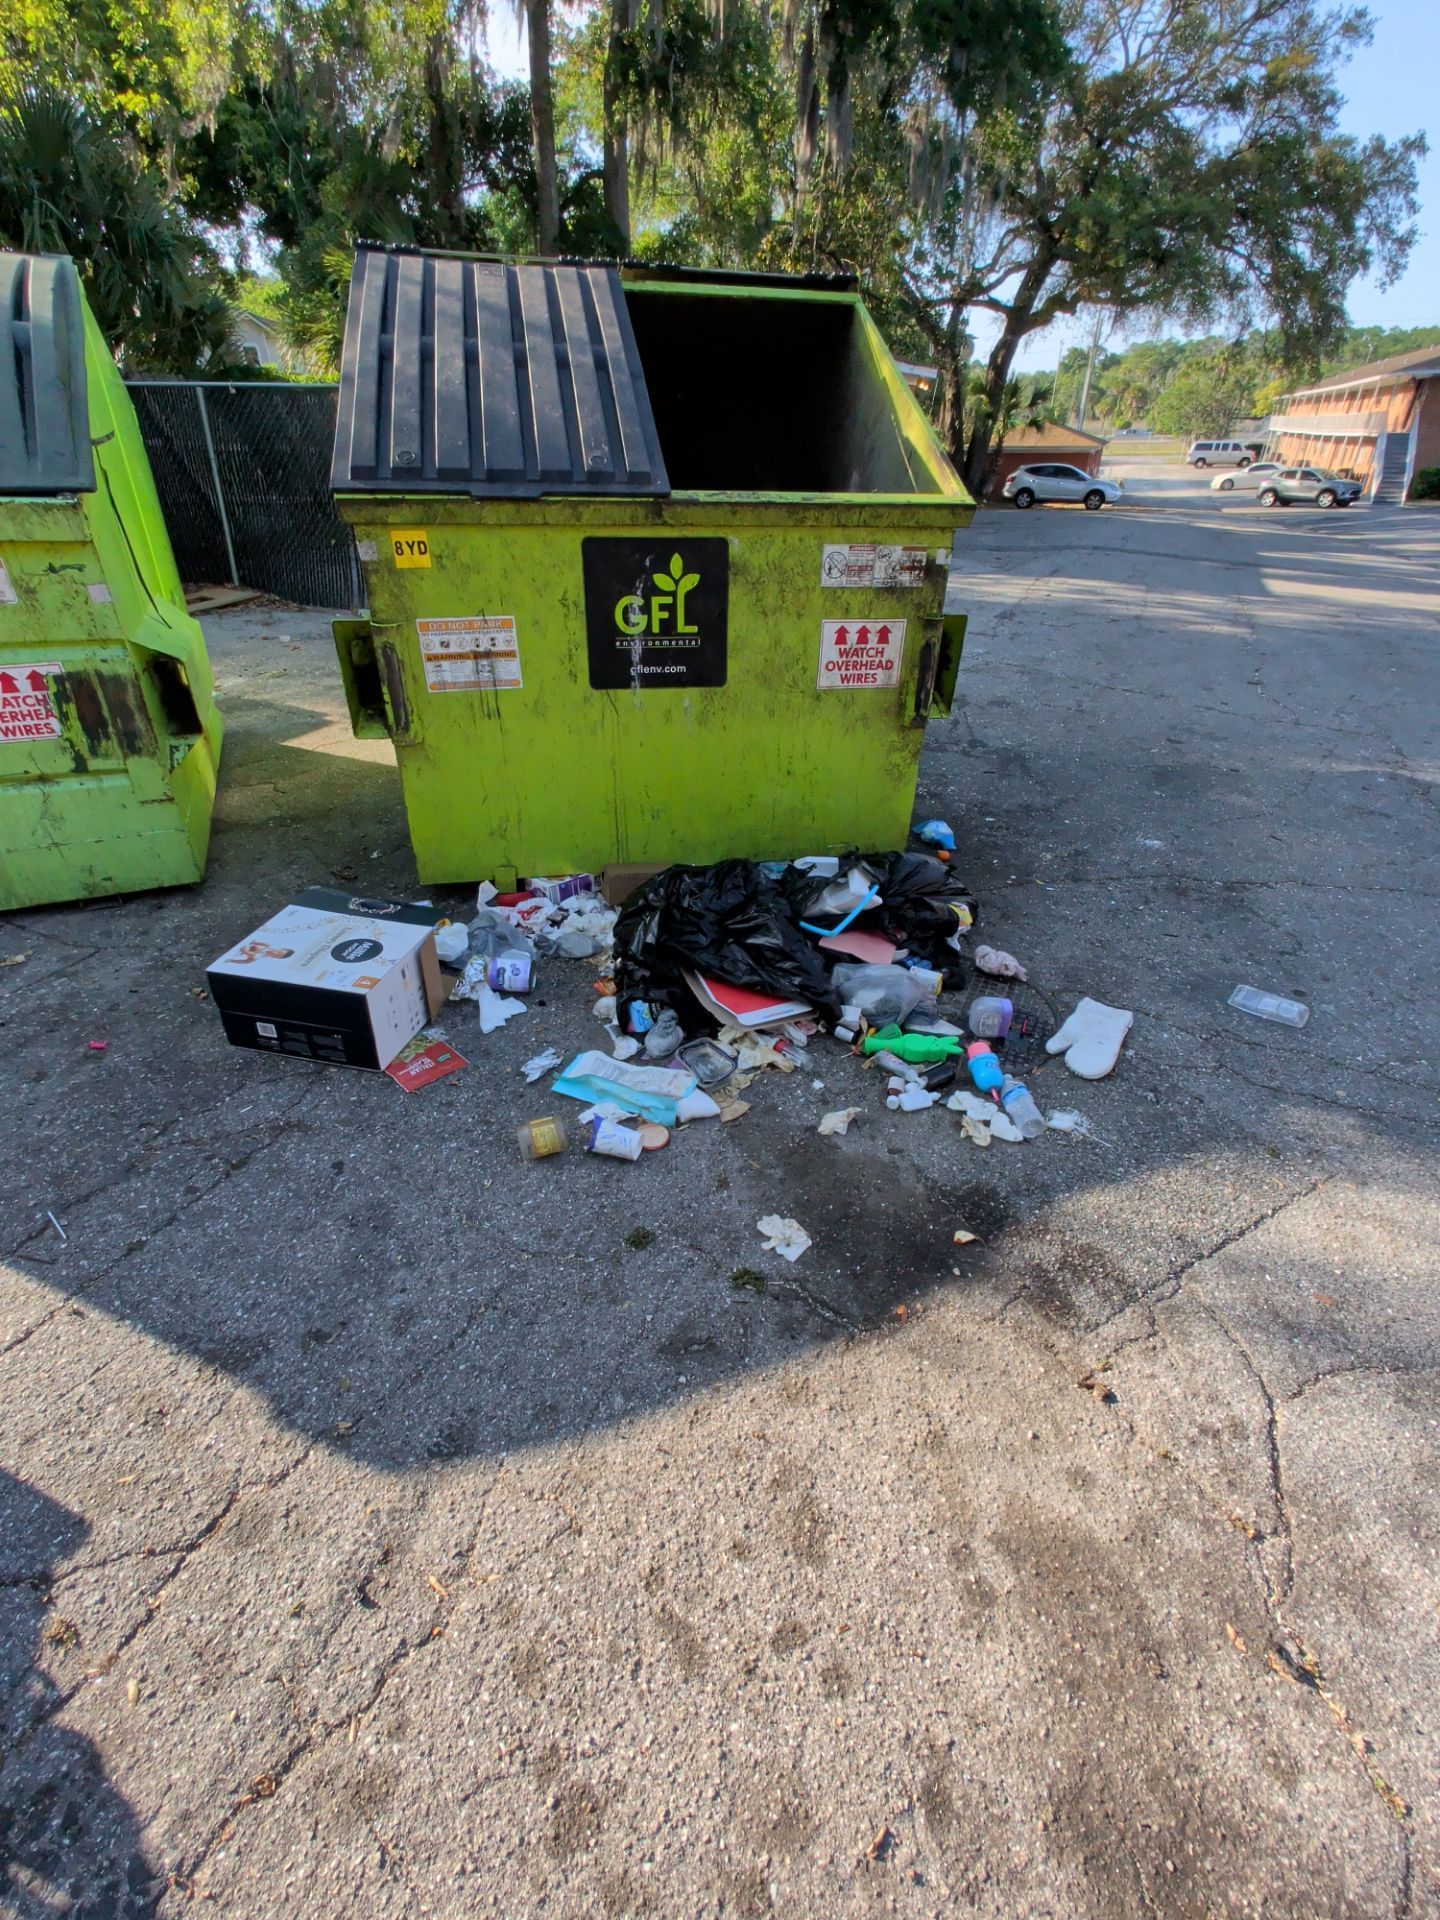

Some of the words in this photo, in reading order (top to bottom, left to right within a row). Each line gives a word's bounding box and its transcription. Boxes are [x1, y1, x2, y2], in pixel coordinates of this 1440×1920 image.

[615, 574, 700, 635] GFL
[428, 622, 446, 631] DO
[447, 621, 469, 630] NOT
[473, 620, 503, 629] PARK
[432, 653, 471, 661] WARNING
[838, 647, 884, 659] WATCH
[630, 664, 687, 676] gflenv.com
[825, 659, 894, 672] OVERHEAD
[840, 673, 878, 685] WIRES
[1, 694, 49, 709] ATCH
[0, 708, 58, 723] ERHEA
[0, 722, 56, 738] WIRES
